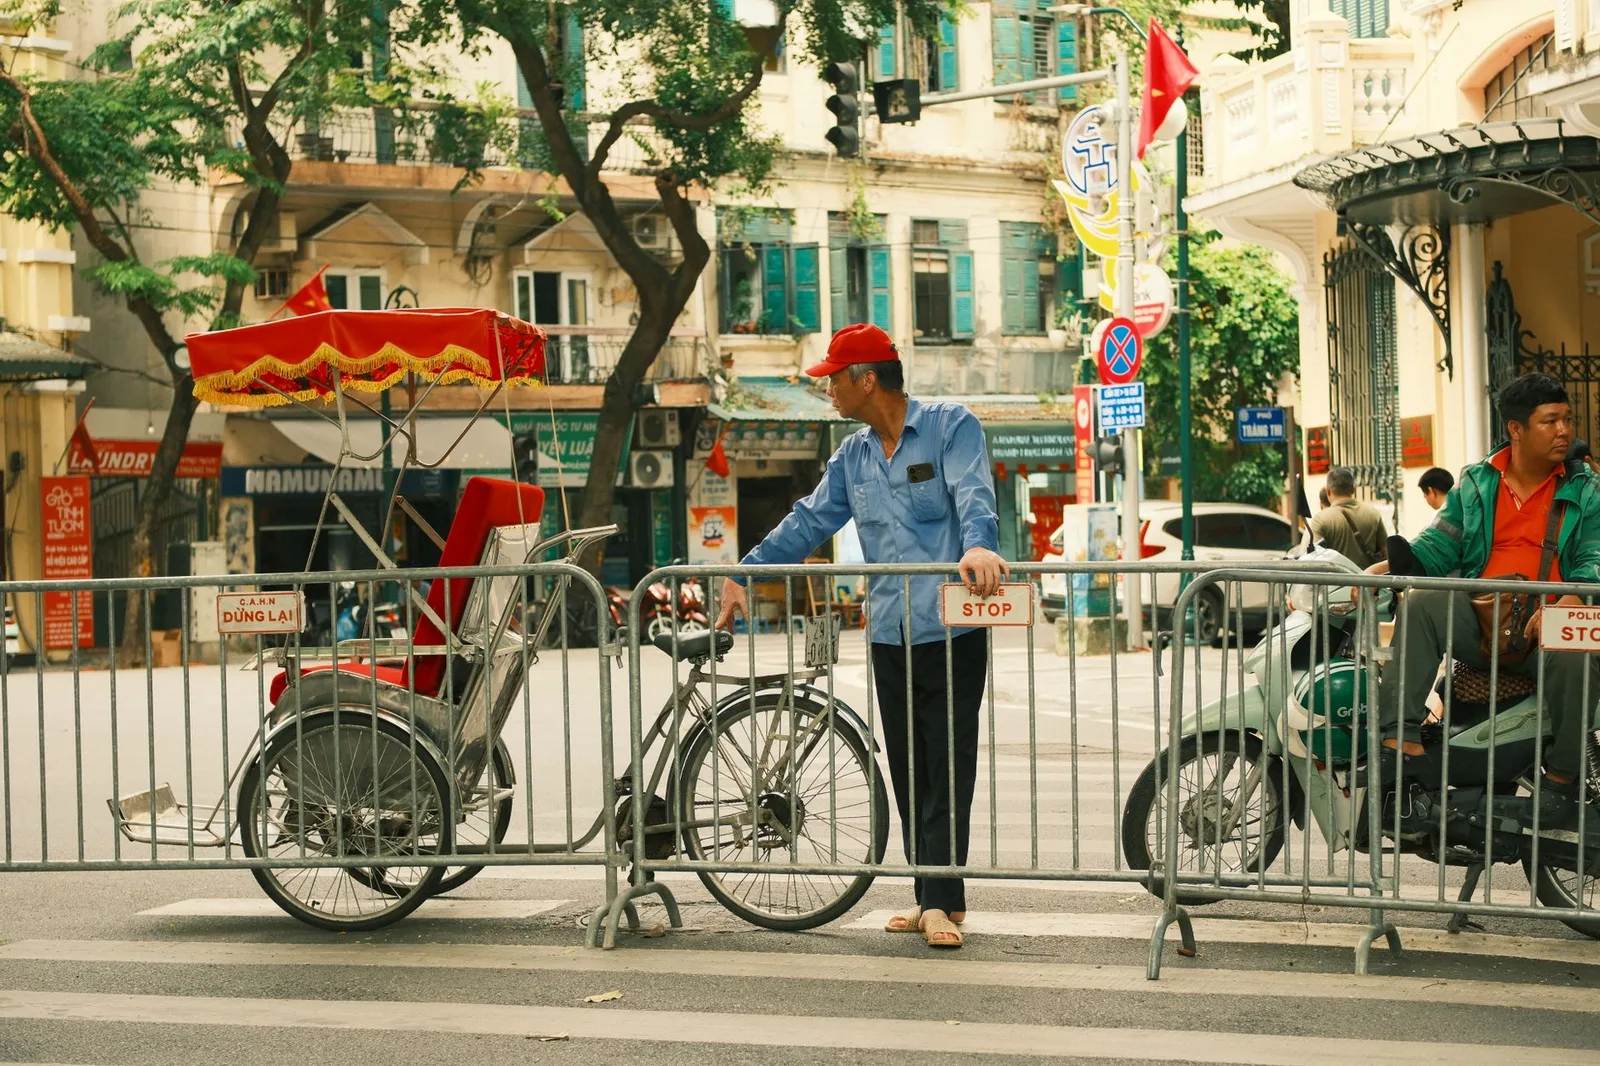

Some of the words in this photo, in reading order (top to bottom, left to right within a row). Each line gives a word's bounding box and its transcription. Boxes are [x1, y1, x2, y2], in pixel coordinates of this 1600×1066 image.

[536, 418, 568, 432] THUỐC
[582, 422, 597, 432] NH
[569, 436, 596, 459] LUẬ
[70, 451, 155, 470] LAUNDR
[969, 587, 1005, 597] PCE
[240, 598, 276, 606] C.A.H.N
[962, 602, 1012, 617] STOP
[223, 607, 265, 623] DỪNG
[268, 609, 293, 624] LẠI
[1336, 703, 1368, 718] Grb
